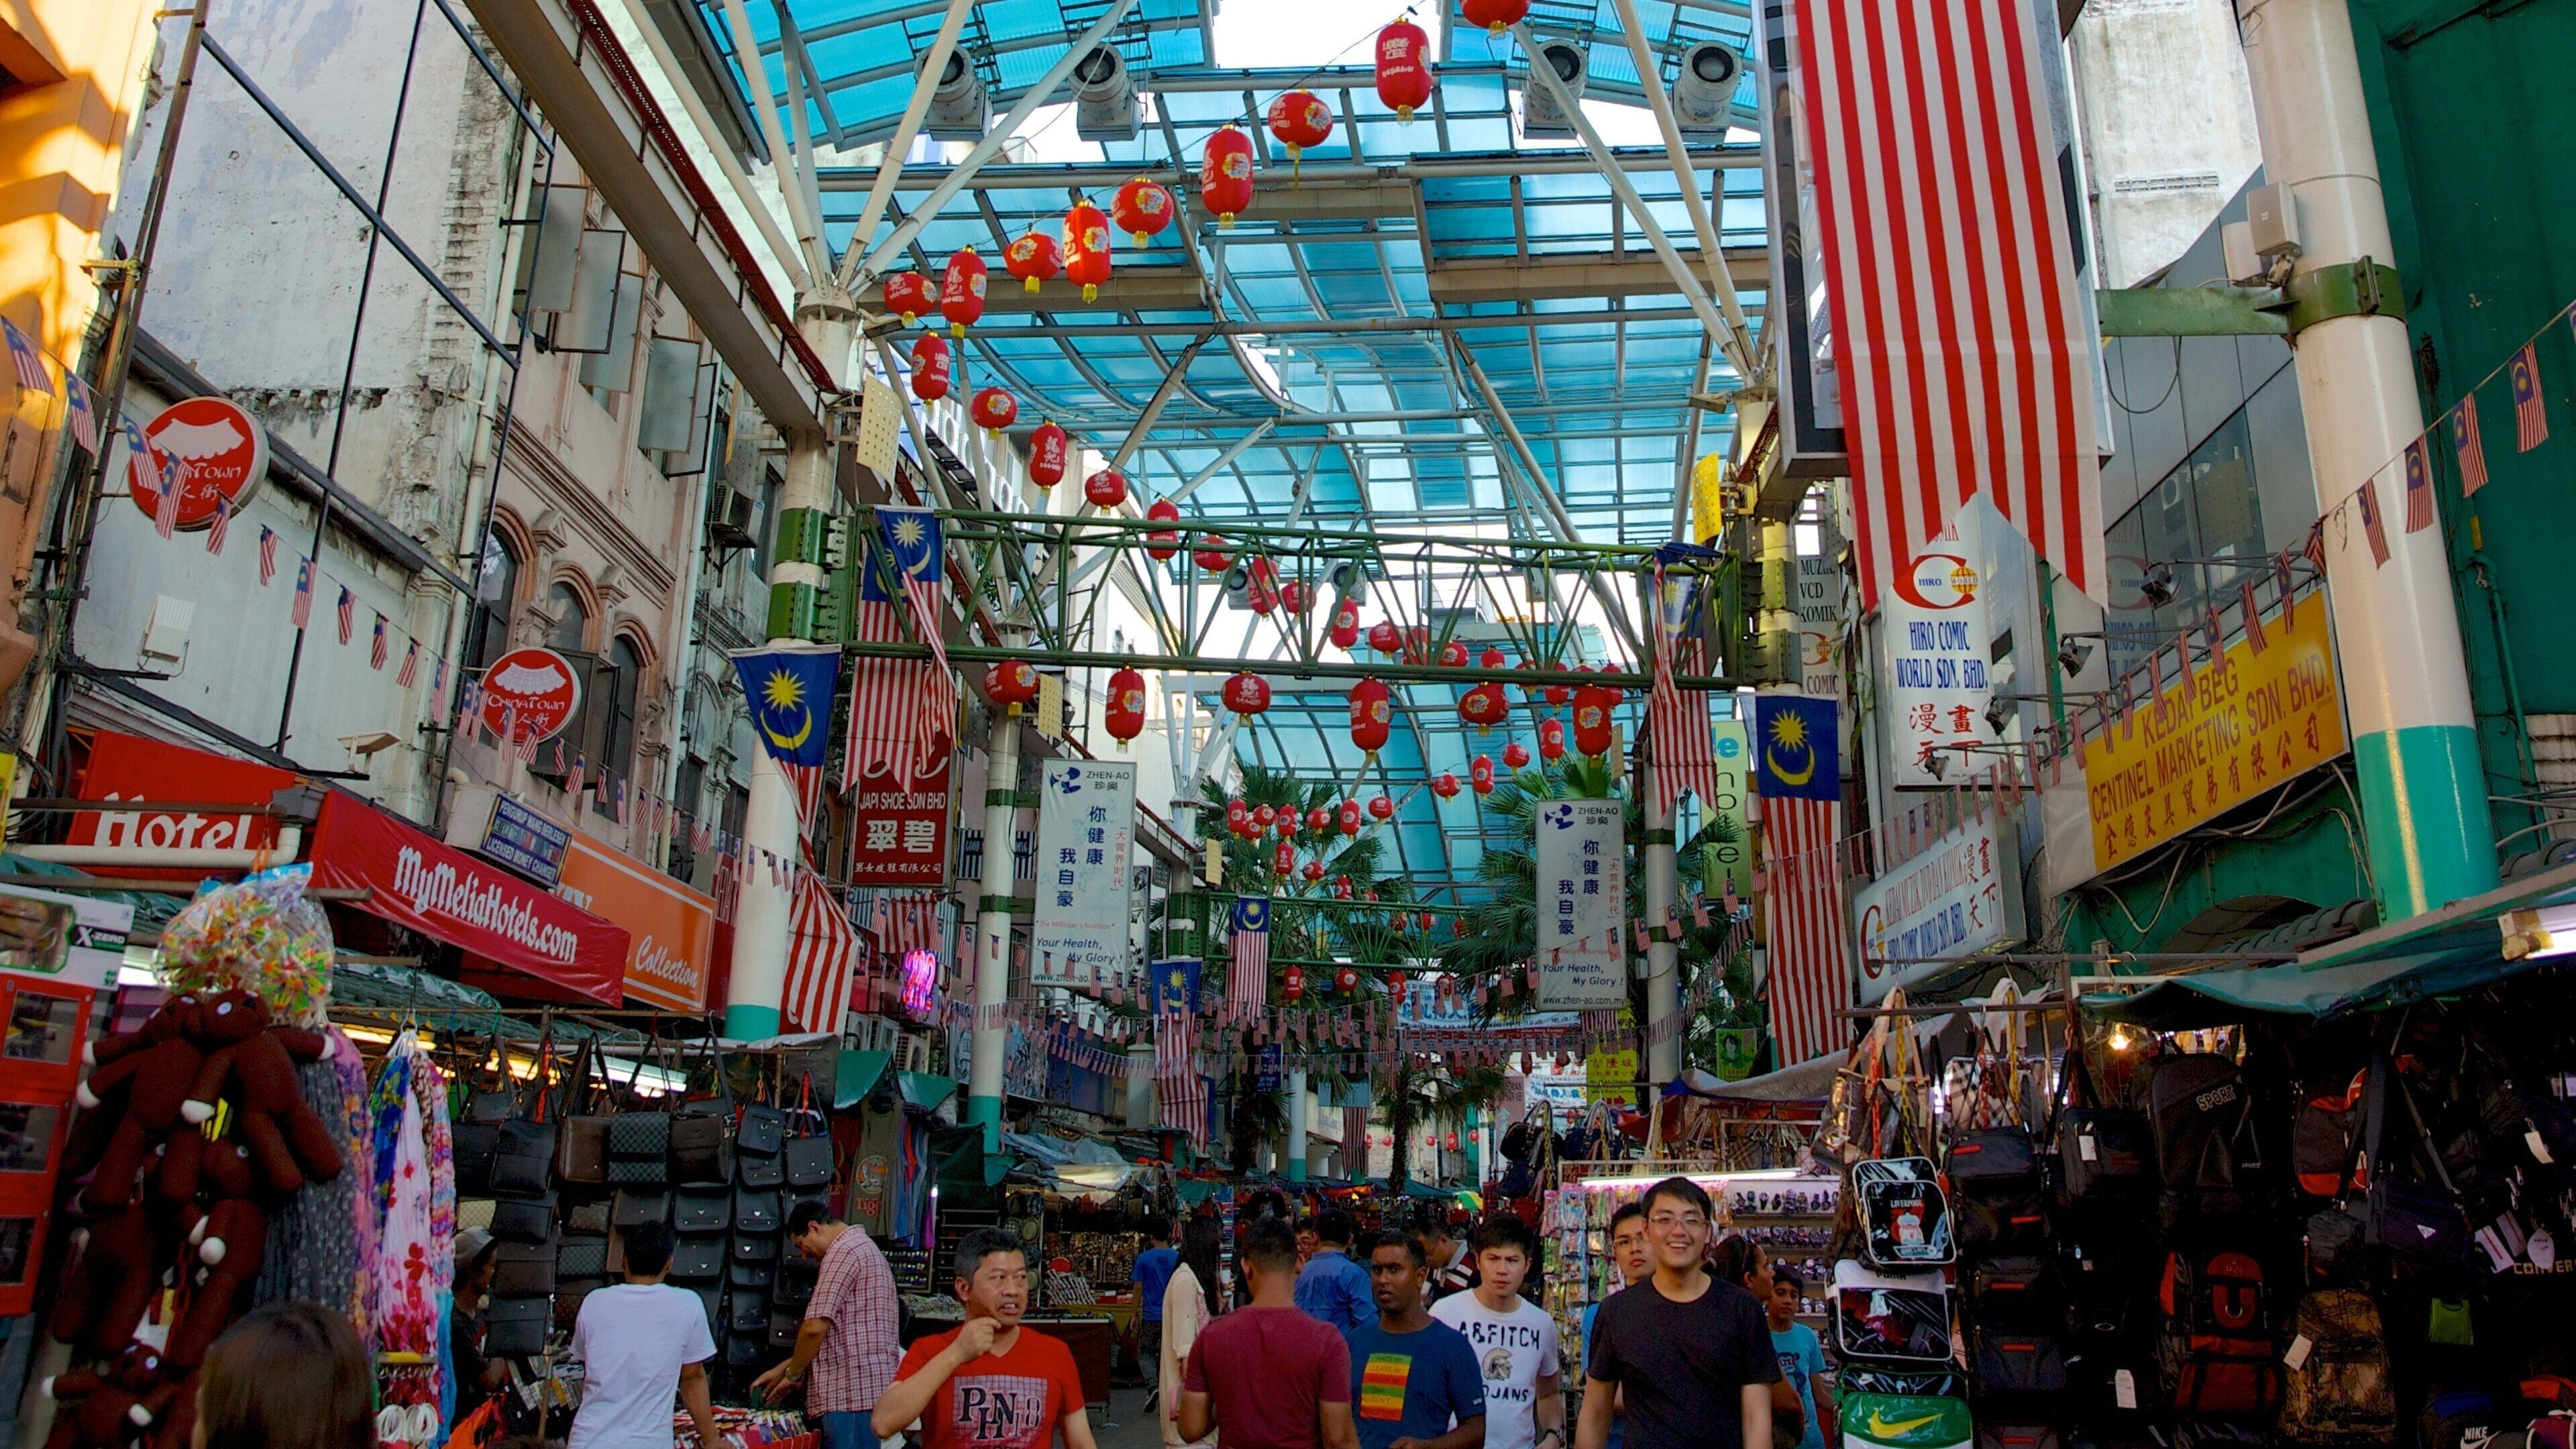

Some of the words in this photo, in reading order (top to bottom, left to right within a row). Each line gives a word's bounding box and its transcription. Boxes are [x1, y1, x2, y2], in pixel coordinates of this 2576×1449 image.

[1800, 582, 1823, 599] VCD
[1918, 578, 1942, 586] HIRO
[1801, 606, 1837, 623] KOMIK
[1909, 621, 1935, 651] HIRO
[1937, 621, 1971, 651] COMIC
[1807, 675, 1839, 694] COMIC
[1896, 658, 1932, 689] WORLD
[1937, 658, 1960, 689] SDN.
[1964, 658, 1988, 689] BHD.
[2198, 657, 2240, 714] BEG
[1909, 704, 1976, 735] 漫畫
[2091, 758, 2155, 824] CENTINEL
[2154, 703, 2242, 789] MARKETING
[2245, 676, 2287, 737] SDN.
[2287, 652, 2330, 713] BHD.
[1086, 771, 1130, 780] ZHEN-AO
[859, 792, 879, 810] JAPI
[881, 792, 905, 810] SHOE
[908, 792, 927, 810] SDN
[927, 792, 946, 810] BHD
[94, 792, 258, 849] Hotel
[865, 819, 936, 853] 翠碧
[1086, 806, 1106, 865] 你健康
[486, 836, 515, 861] LICENSED
[513, 849, 534, 869] MONEY
[532, 859, 557, 882] CHANGER
[1583, 839, 1599, 896] 你健康
[1057, 848, 1077, 908] 我自豪
[393, 843, 578, 965] MyMeliaHotels.com
[1558, 879, 1574, 936] 我自豪
[1036, 937, 1060, 947] Your
[1063, 938, 1102, 951] Health,
[1067, 952, 1082, 963] My
[1085, 953, 1115, 965] Glory
[635, 934, 698, 989] Collection
[1543, 963, 1564, 973] Your
[1567, 964, 1604, 974] Health,
[1572, 976, 1587, 987] My
[1589, 976, 1617, 987] Glory
[1543, 996, 1625, 1006] www.zhen-ao.com.my
[2196, 1084, 2237, 1112] SPORT
[1890, 1199, 1923, 1208] LIVERPOOL
[2464, 1426, 2489, 1440] NIKE
